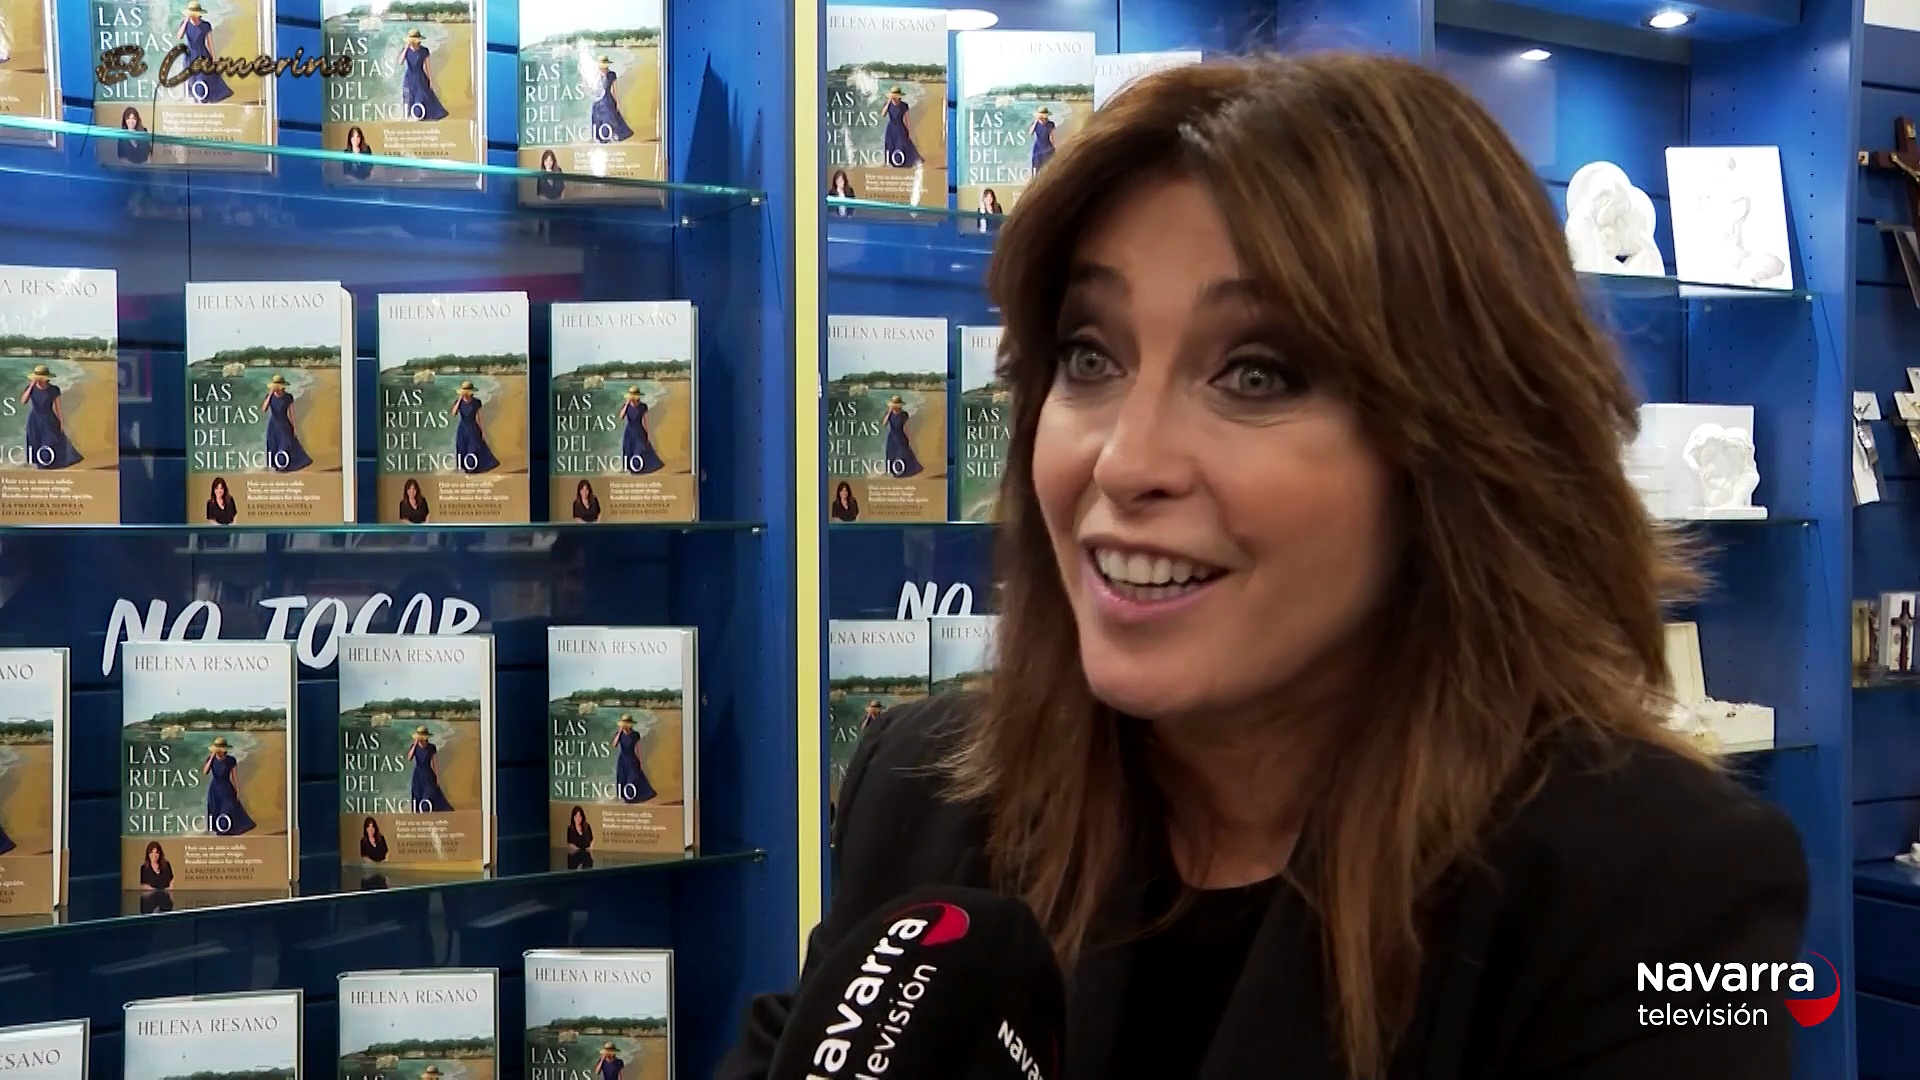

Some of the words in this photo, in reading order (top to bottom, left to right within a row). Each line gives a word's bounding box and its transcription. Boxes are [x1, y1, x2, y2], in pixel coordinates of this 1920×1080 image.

[98, 7, 143, 28] LAS
[882, 18, 936, 32] RESANO
[330, 37, 368, 57] LAS
[525, 64, 560, 82] LAS
[330, 81, 368, 100] DEL
[525, 85, 585, 102] RUTAS
[827, 91, 855, 108] AS
[330, 102, 426, 122] SILENCIO
[525, 105, 561, 123] DEL
[970, 111, 1003, 128] LAS
[525, 123, 613, 144] SILENCIO
[970, 131, 1026, 146] RUTAS
[829, 149, 905, 166] ILENCIO
[970, 149, 1003, 164] DEL
[970, 167, 1036, 182] SILENCI
[21, 279, 97, 297] RESANO
[197, 294, 256, 310] HELENA
[262, 293, 324, 309] RESANO
[389, 305, 445, 320] HELENA
[452, 304, 511, 319] RESANO
[561, 314, 614, 328] HELENA
[620, 313, 677, 328] RESANO
[829, 325, 878, 339] HELENA
[884, 327, 935, 341] RESANO
[193, 383, 232, 403] LAS
[385, 389, 423, 408] LAS
[557, 393, 592, 411] LAS
[193, 406, 259, 425] RUTAS
[828, 401, 857, 417] AS
[966, 407, 1000, 423] LAS
[385, 410, 449, 429] RUTAS
[557, 414, 617, 432] RUTAS
[193, 429, 232, 447] DEL
[385, 432, 423, 450] DEL
[966, 426, 1011, 441] RUTA
[557, 436, 591, 452] DEL
[966, 444, 1000, 459] DEL
[193, 450, 290, 470] SILENCIO
[385, 453, 479, 472] SILENCIO
[557, 455, 643, 473] SILENCIO
[102, 597, 222, 677] NO
[862, 631, 916, 644] RESANO
[348, 647, 401, 662] HELENA
[407, 649, 465, 664] RESANO
[557, 639, 607, 655] HELENA
[612, 641, 667, 656] RESANO
[135, 655, 197, 672] HELENA
[203, 655, 270, 671] RESANO
[554, 719, 587, 737] LAS
[344, 731, 380, 750] LAS
[554, 740, 610, 758] RUTAS
[128, 745, 170, 764] LAS
[344, 753, 405, 772] RUTAS
[128, 768, 199, 788] RUTAS
[554, 760, 587, 778] DEL
[344, 775, 380, 794] DEL
[554, 780, 637, 800] SILENCIO
[128, 791, 170, 811] DEL
[345, 797, 433, 814] SILENCIO
[128, 813, 232, 833] SILENCIO
[535, 967, 588, 982] HELENA
[594, 969, 651, 984] RESANO
[351, 990, 409, 1004] HELENA
[416, 987, 478, 1003] RESANO
[138, 1019, 203, 1036] HELENA
[210, 1015, 278, 1032] RESANO
[531, 1048, 568, 1065] LAS
[997, 1019, 1044, 1080] Nava
[531, 1067, 592, 1080] RUTAS
